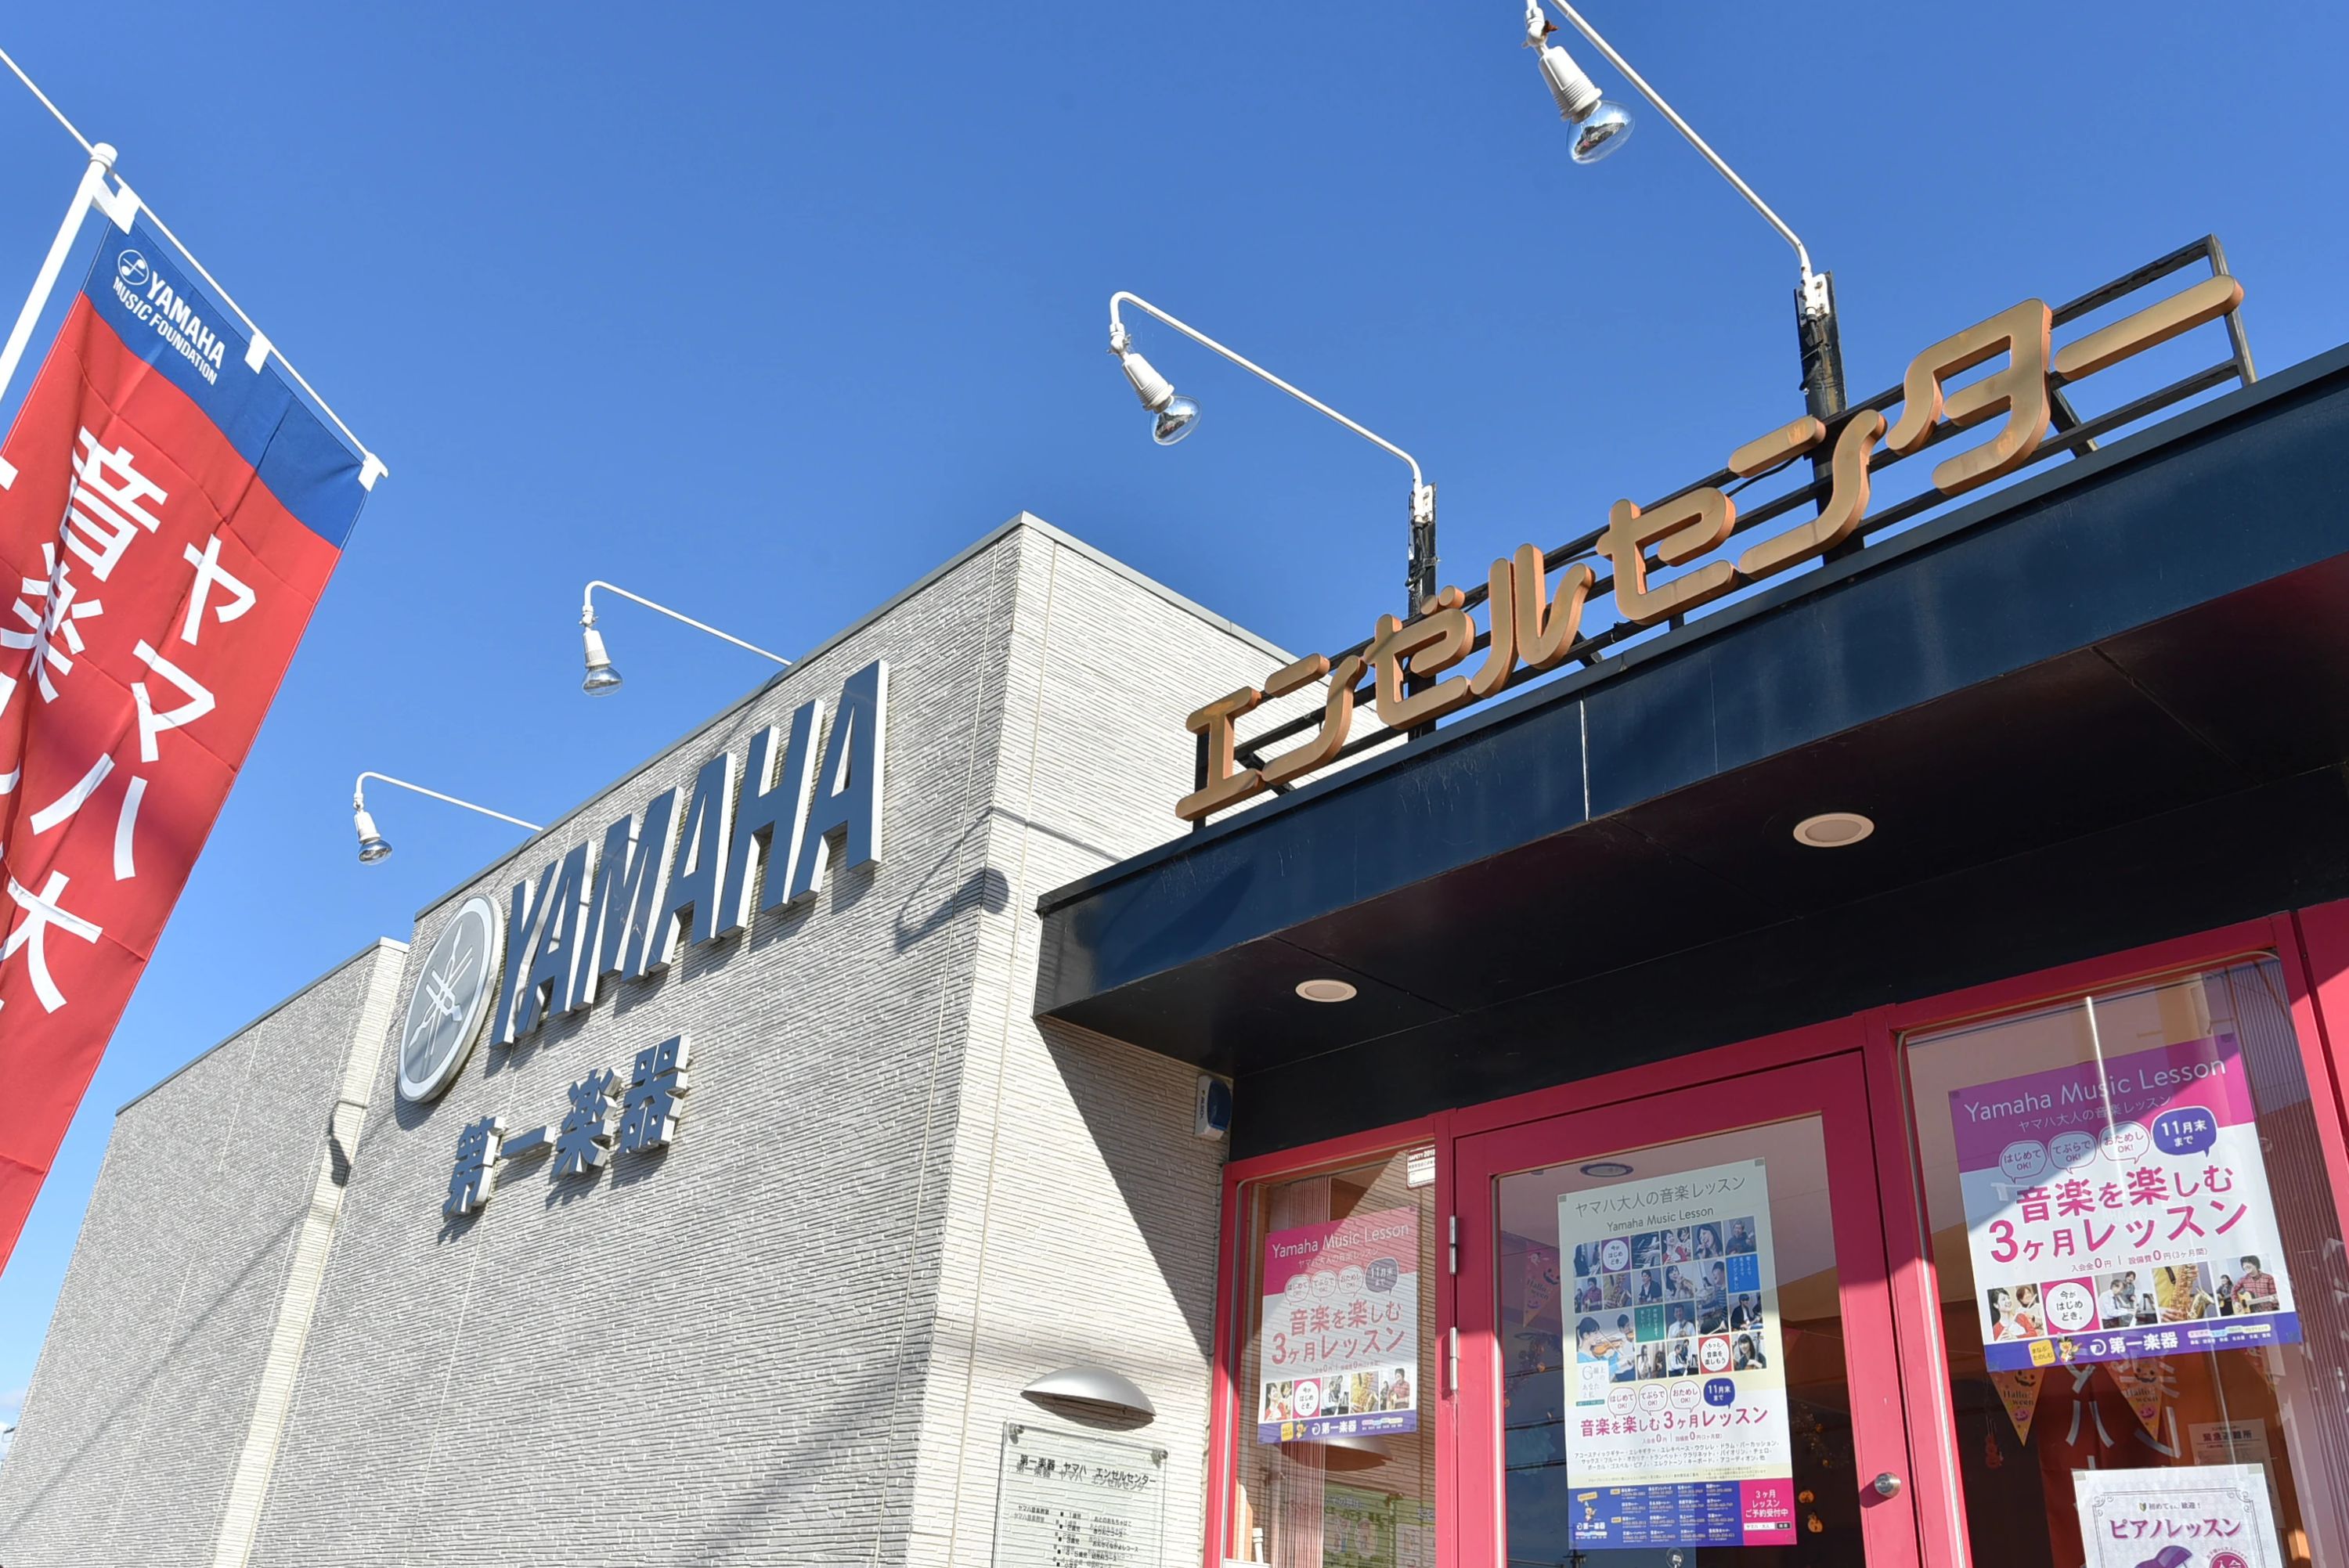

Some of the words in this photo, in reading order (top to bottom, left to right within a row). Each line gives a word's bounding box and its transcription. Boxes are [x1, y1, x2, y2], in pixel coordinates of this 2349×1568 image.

[149, 271, 226, 369] YAMAHA
[113, 276, 151, 322] MUSIC
[150, 312, 218, 385] FOUNDATION
[1175, 274, 2243, 822] エンゼルセンター
[490, 659, 888, 1047] YAMAHA
[1964, 1090, 2052, 1123] Yamaha
[2061, 1076, 2132, 1105] Music
[2139, 1058, 2228, 1089] Lesson
[2018, 1095, 2171, 1133] ヤマハ大人の音楽レッスン
[443, 1033, 692, 1217] 第一楽器
[2161, 1119, 2207, 1137] 11月末
[2103, 1130, 2145, 1146] おためし
[2174, 1134, 2195, 1147] まで
[2052, 1139, 2091, 1155] てぶらで
[2117, 1142, 2135, 1154] OK!
[2003, 1148, 2043, 1165] はじめて
[2065, 1152, 2082, 1162] OK!
[2015, 1161, 2033, 1171] OK!
[1575, 1177, 1745, 1217] ヤマハ大人の音楽レッスン
[2016, 1164, 2234, 1224] 音楽を楽しむ
[1607, 1218, 1644, 1232] Yamaha
[1647, 1212, 1676, 1225] Music
[1679, 1206, 1714, 1220] Lesson
[1272, 1238, 1319, 1259] Yamaha
[1322, 1231, 1360, 1250] Music
[1364, 1224, 1409, 1242] Lesson
[1370, 1267, 1396, 1278] 11月末
[2059, 1289, 2077, 1299] 今が
[2056, 1299, 2084, 1313] はじめ
[1290, 1299, 1402, 1337] 音楽を楽しむ
[2061, 1312, 2084, 1322] どき。
[2109, 1332, 2178, 1354] 第一楽器
[1610, 1394, 1634, 1403] はじめて
[1672, 1387, 1698, 1397] おためし
[1708, 1385, 1731, 1395] 11月末
[1321, 1419, 1357, 1434] 第一楽器
[1020, 1454, 1055, 1471] 第一楽器
[1063, 1462, 1087, 1476] ヤマハ
[1096, 1468, 1156, 1485] エンゼルセンター
[1752, 1499, 1781, 1509] レッスン
[1745, 1508, 1789, 1519] ご予約受付中
[2109, 1518, 2241, 1540] ピアノレッスン
